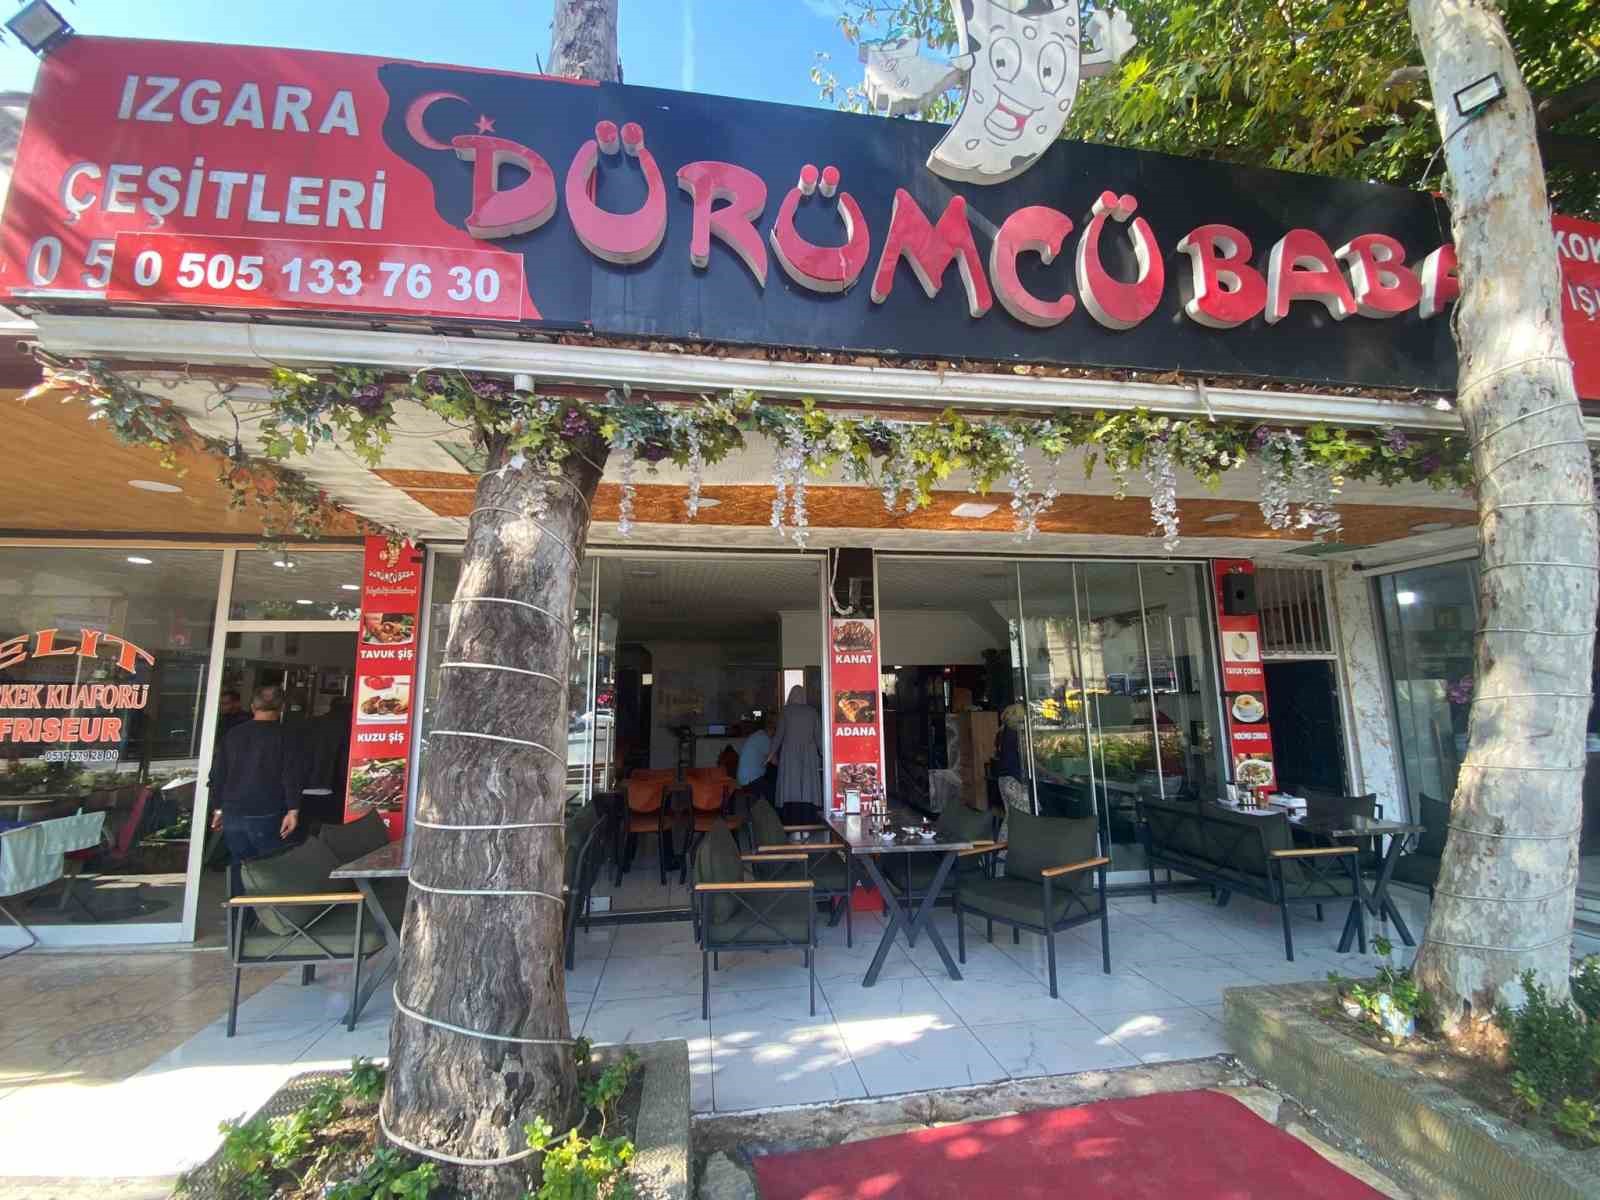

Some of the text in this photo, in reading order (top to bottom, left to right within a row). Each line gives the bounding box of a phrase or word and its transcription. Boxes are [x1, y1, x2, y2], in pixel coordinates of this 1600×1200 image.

[117, 75, 360, 136] IZGARA
[60, 156, 385, 231] ÇEŞİTLERİ
[134, 250, 500, 302] 0 505 133 76 30
[360, 647, 413, 661] TAVUK ŞİŞ
[835, 655, 873, 664] KANAT
[0, 684, 44, 709] KEK
[0, 717, 122, 742] FRISEUR
[357, 730, 404, 744] KUZU ŞİŞ
[835, 727, 876, 737] ADANA
